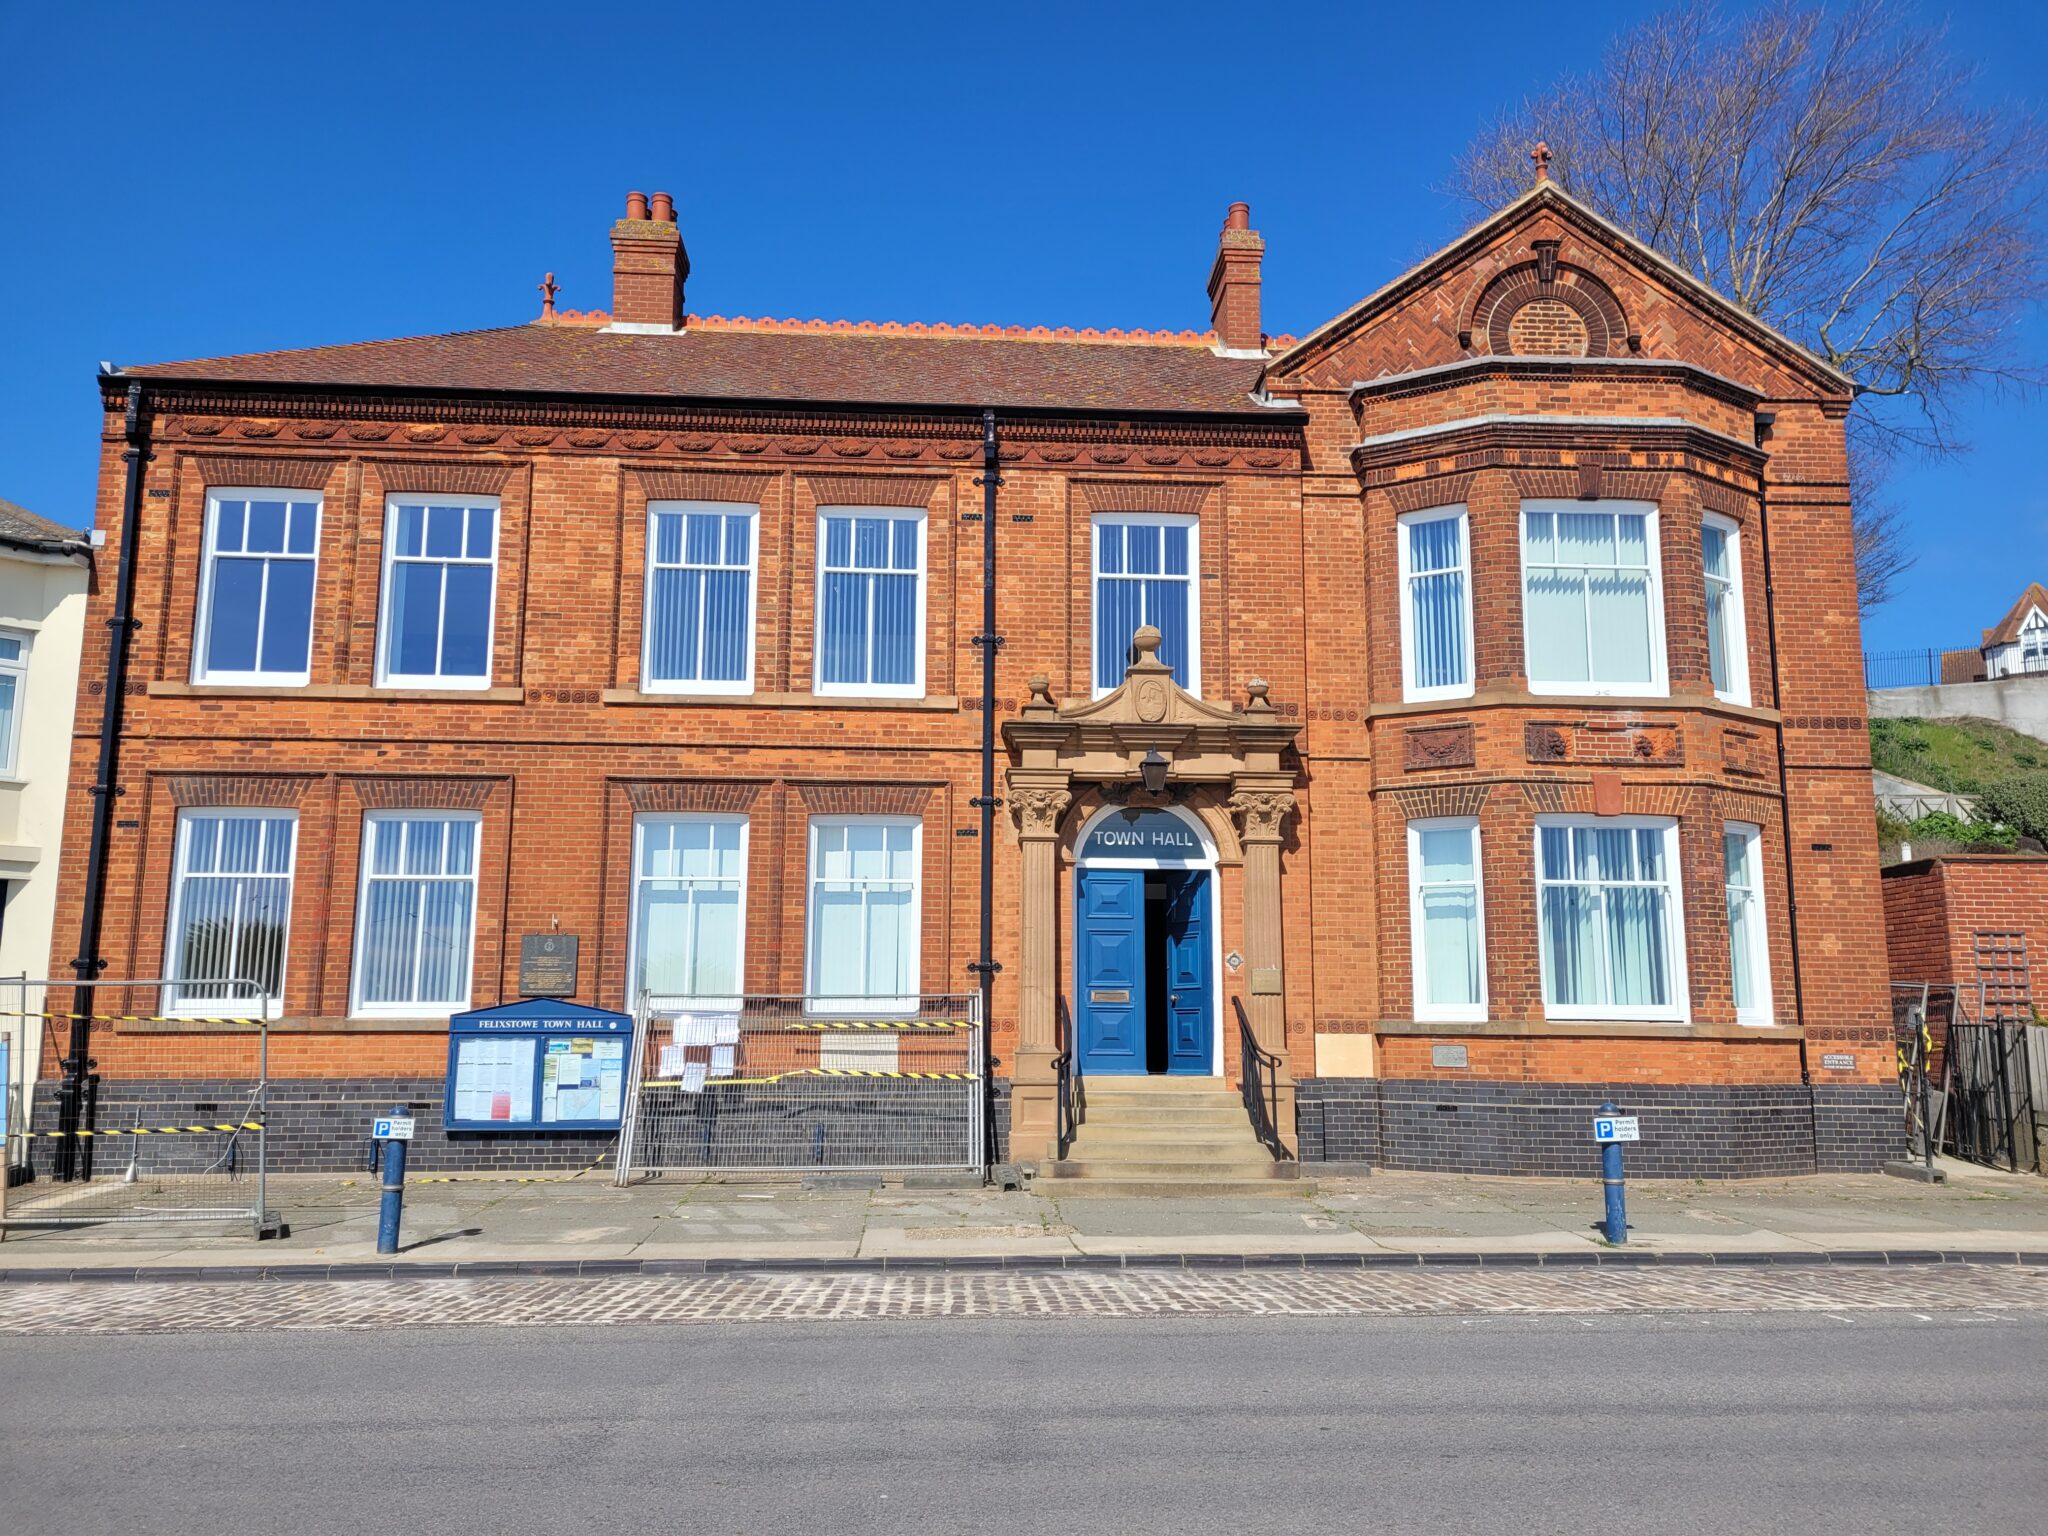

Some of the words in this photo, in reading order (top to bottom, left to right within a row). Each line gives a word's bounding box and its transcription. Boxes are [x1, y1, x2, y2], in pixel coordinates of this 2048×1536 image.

[1094, 831, 1144, 846] TOWN
[1152, 832, 1193, 846] HALL
[479, 1020, 538, 1029] FELIXSTOWE
[542, 1020, 572, 1029] TOWN
[577, 1020, 604, 1029] HALL
[378, 1122, 389, 1135] P
[1600, 1122, 1611, 1137] P
